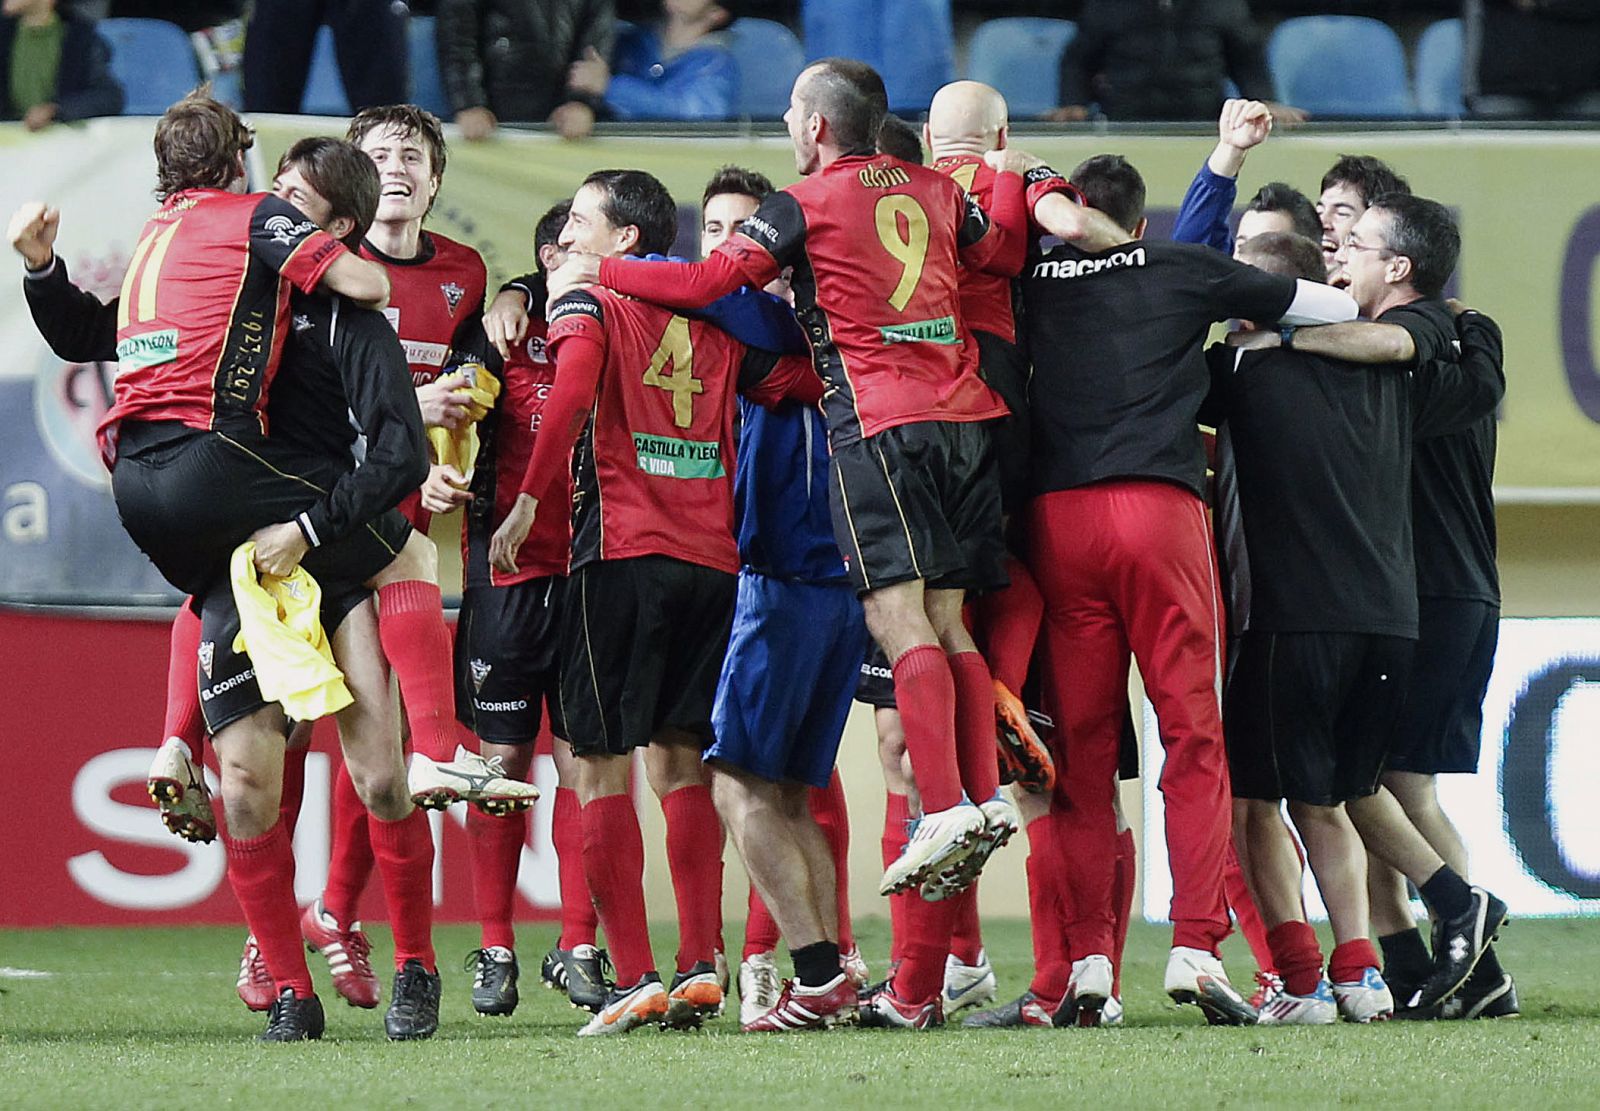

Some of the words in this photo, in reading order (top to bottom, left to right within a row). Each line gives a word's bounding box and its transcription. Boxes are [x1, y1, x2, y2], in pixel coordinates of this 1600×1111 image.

[874, 193, 930, 313] 9
[1031, 247, 1146, 279] macron
[116, 217, 183, 328] 11
[642, 314, 704, 430] 4
[634, 437, 686, 459] CASTILLA
[688, 444, 697, 459] Y
[697, 443, 721, 460] LEÓ
[648, 457, 676, 476] VIDA
[3, 480, 50, 543] a
[212, 668, 256, 695] CORREO
[480, 699, 528, 712] CORREO
